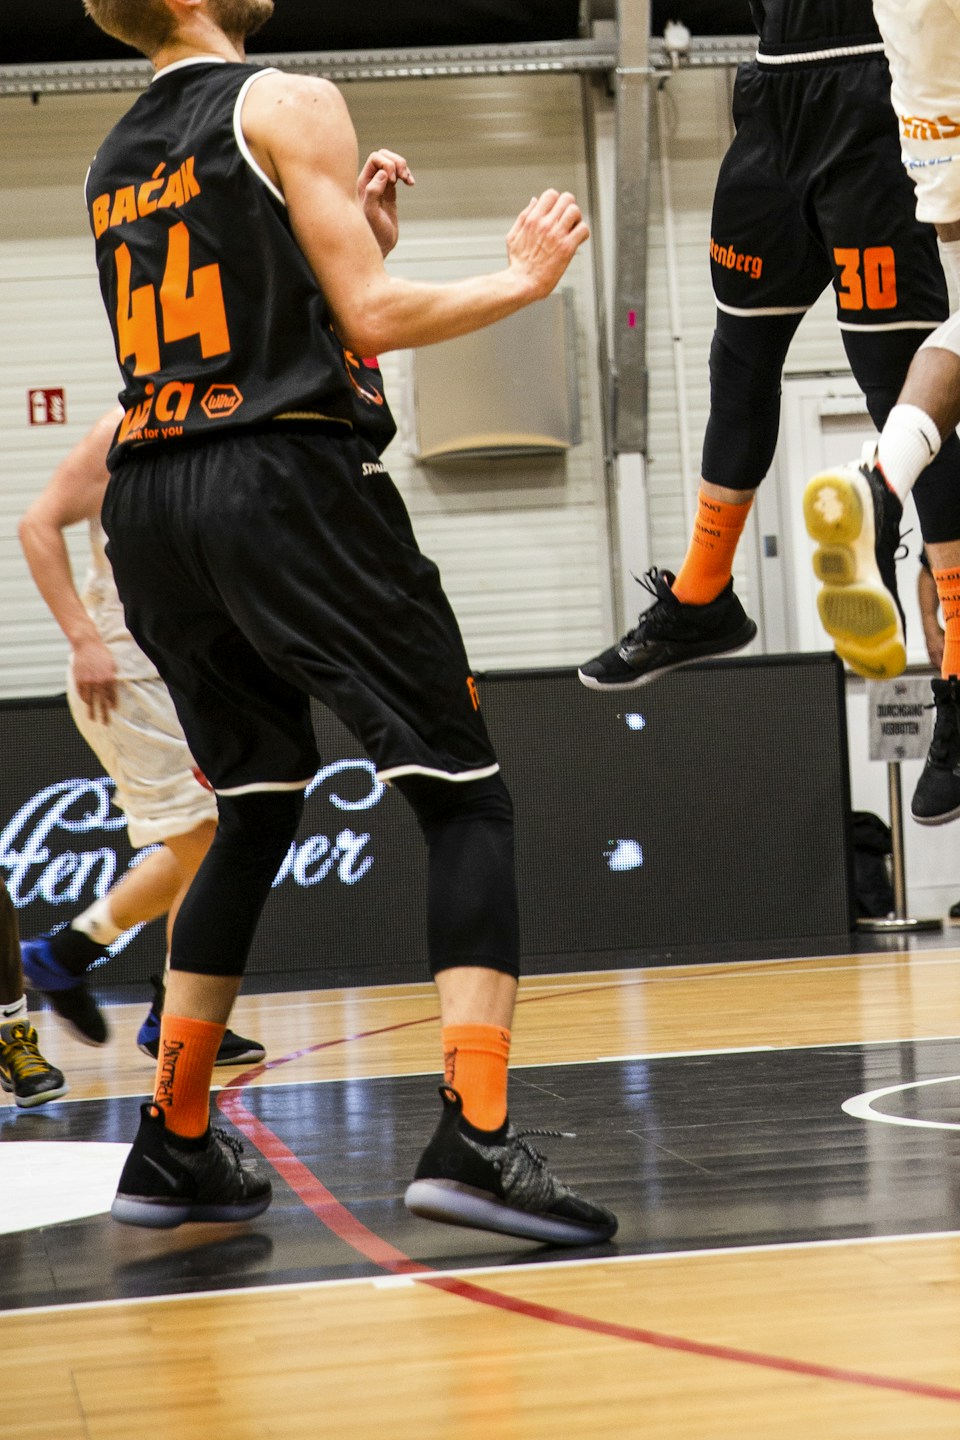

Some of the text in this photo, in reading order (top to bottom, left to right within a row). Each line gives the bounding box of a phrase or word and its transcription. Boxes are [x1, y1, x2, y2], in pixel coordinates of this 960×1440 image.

[114, 220, 231, 377] 44
[833, 246, 898, 311] 30
[161, 425, 184, 440] you
[155, 1039, 185, 1107] SPALDING
